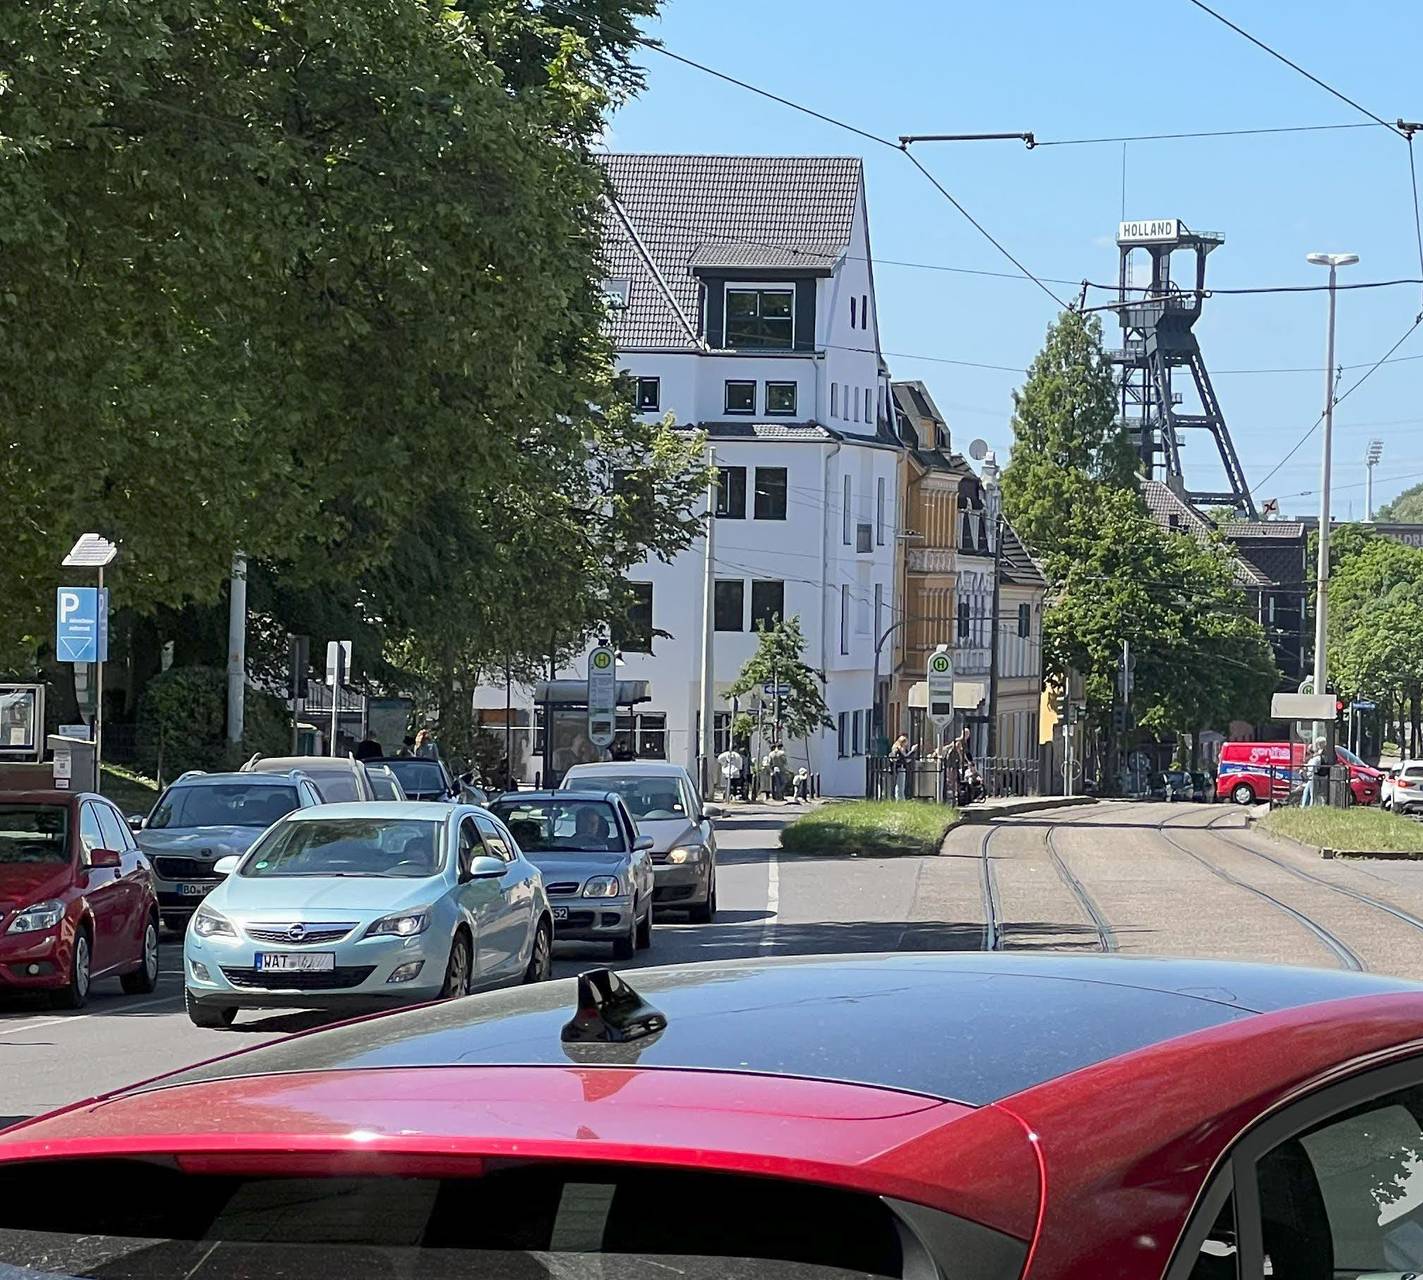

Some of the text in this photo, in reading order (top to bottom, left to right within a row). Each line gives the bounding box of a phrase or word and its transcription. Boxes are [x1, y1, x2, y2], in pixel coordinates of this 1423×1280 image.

[1123, 222, 1172, 237] HOLLAND
[61, 593, 80, 624] P
[598, 655, 606, 665] H
[937, 660, 944, 668] H
[263, 954, 288, 968] WAT
